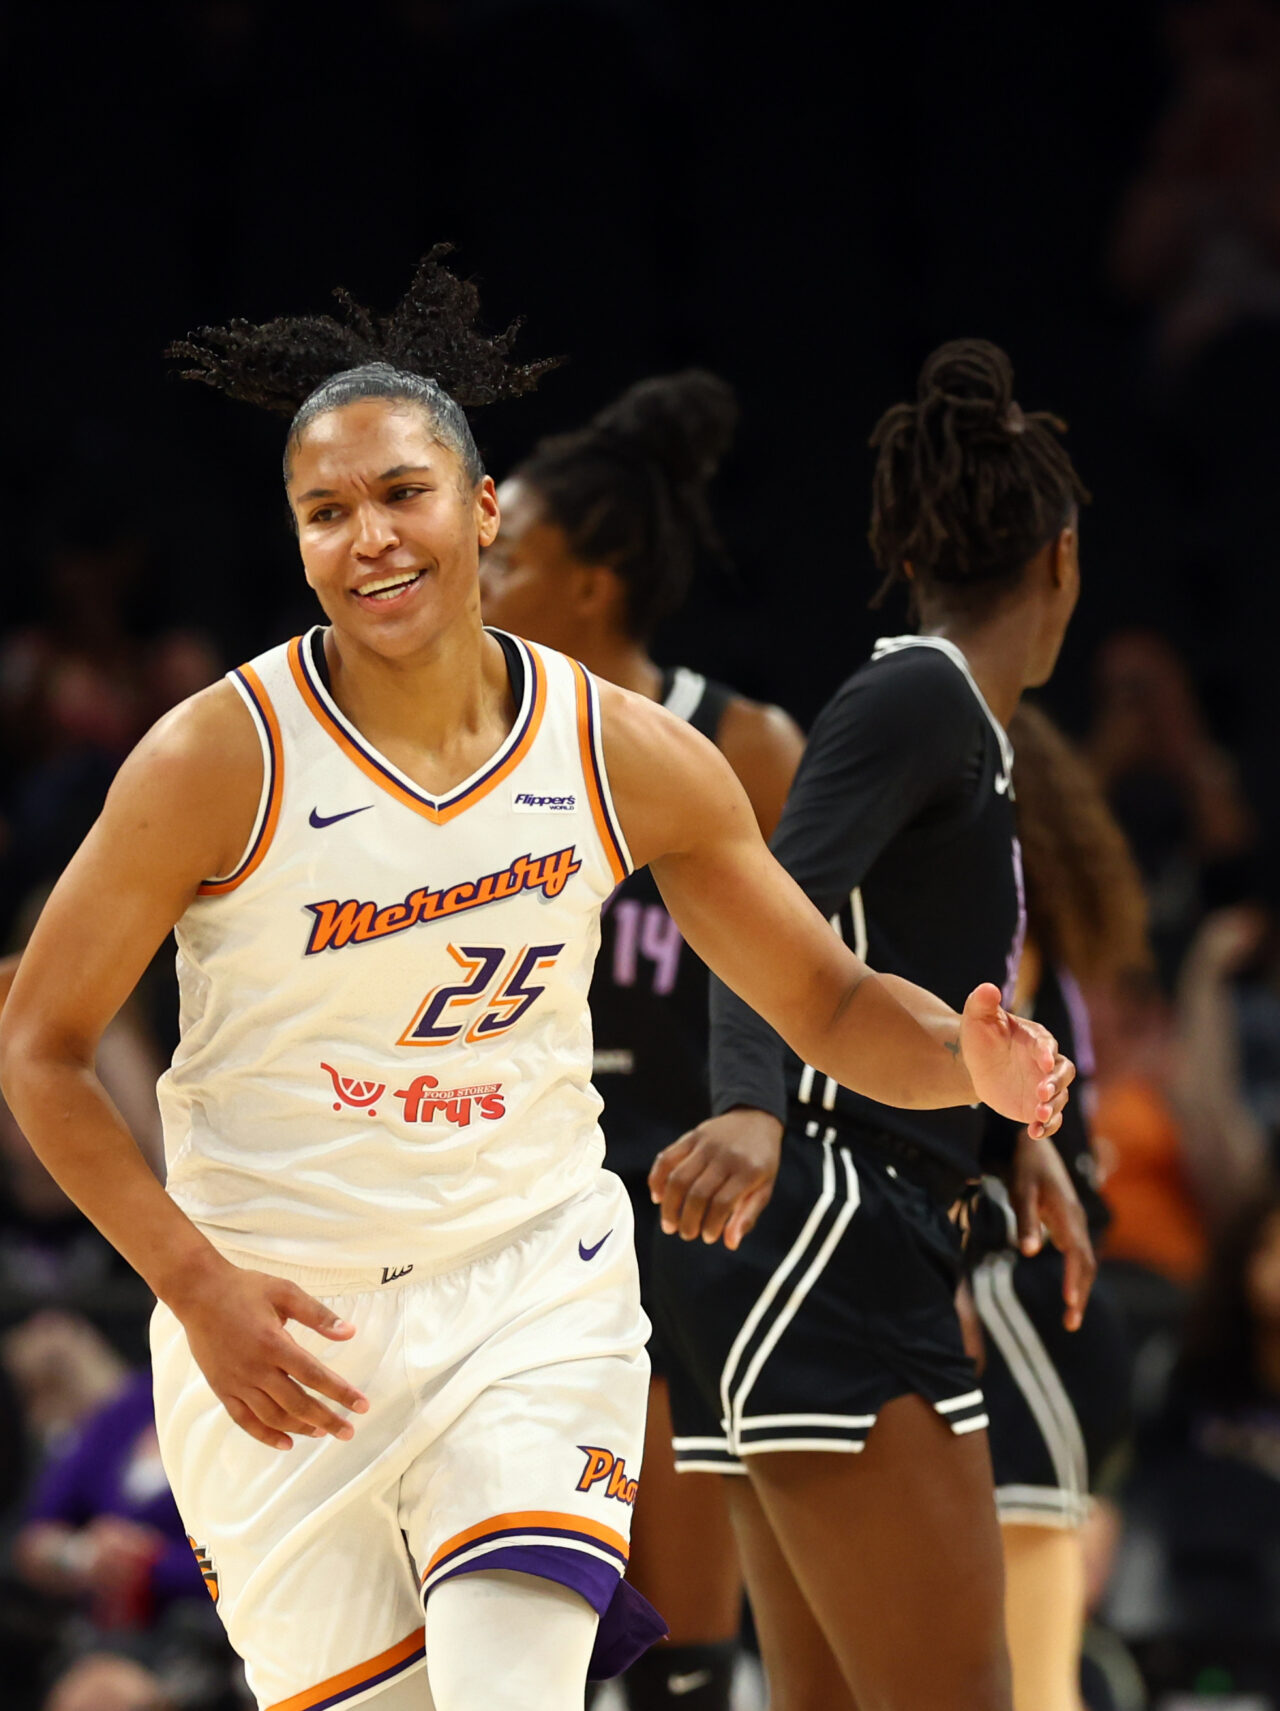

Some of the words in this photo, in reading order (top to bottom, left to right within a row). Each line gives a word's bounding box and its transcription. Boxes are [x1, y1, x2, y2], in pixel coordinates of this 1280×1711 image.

[514, 793, 576, 807] Flipper's
[303, 844, 583, 957] Mercury
[611, 899, 685, 994] 14
[394, 942, 567, 1048] 25
[393, 1075, 506, 1127] fry's
[423, 1090, 455, 1099] FOOD
[456, 1084, 498, 1097] STORES
